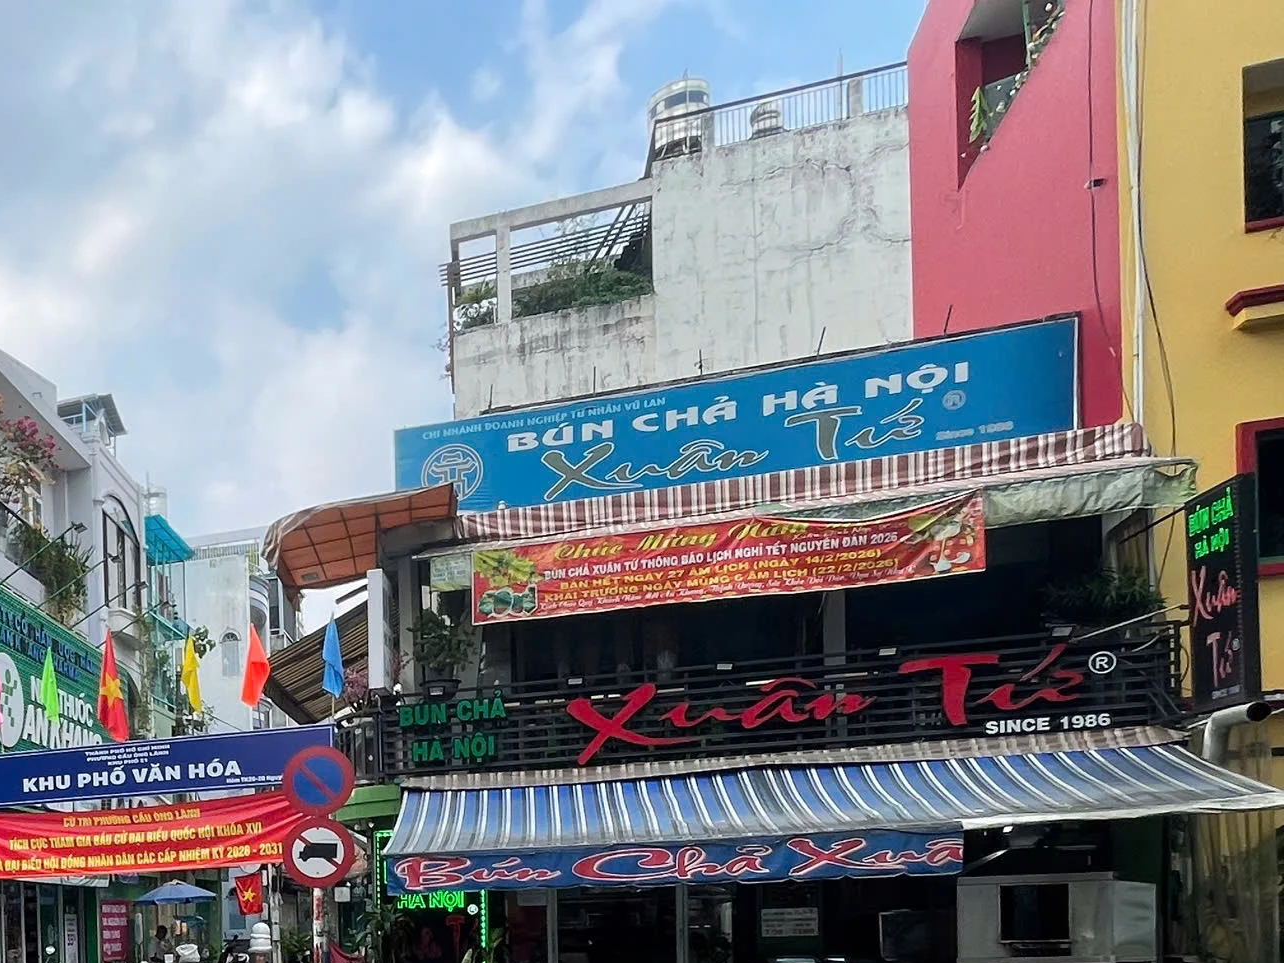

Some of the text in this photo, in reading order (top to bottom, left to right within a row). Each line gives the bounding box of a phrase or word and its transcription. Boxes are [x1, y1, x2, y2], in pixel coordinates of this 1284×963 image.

[422, 430, 441, 440] CHI
[443, 423, 482, 438] NHÁNH
[485, 418, 524, 431] DOANH
[527, 412, 567, 428] NGHIỆP
[588, 403, 623, 417] NHÂN
[643, 397, 666, 409] LAN
[507, 362, 970, 453] BÚN CHẢ HÀ NỘI
[540, 398, 924, 502] Xuân Tứ
[1188, 505, 1210, 537] BÚN
[544, 569, 566, 581] BÚN
[568, 565, 590, 578] CHẢ
[592, 563, 621, 576] XUÂN
[640, 556, 678, 569] THÔNG
[681, 552, 704, 564] BÁO
[706, 548, 732, 563] LỊCH
[765, 541, 787, 556] TẾT
[790, 535, 840, 553] NGUYÊN
[870, 532, 898, 543] 2026
[668, 569, 684, 578] 27
[716, 561, 749, 574] LỊCH
[544, 591, 578, 602] KHAI
[773, 568, 807, 580] LỊCH
[398, 688, 506, 728] BÚN CHẢ
[567, 643, 1084, 765] Xuân Tứ
[985, 713, 1112, 735] SINCE 1986
[412, 732, 496, 763] HÀ NỘI
[23, 756, 242, 793] KHU PHỐ VĂN HÓA
[50, 837, 74, 849] THAM
[76, 836, 91, 847] GIA
[170, 825, 196, 841] QUỐC
[217, 822, 244, 837] KHÓA
[245, 821, 262, 834] XVI
[88, 853, 114, 868] NHÂN
[115, 852, 135, 866] DÂN
[136, 851, 156, 865] CÁC
[157, 847, 176, 863] CẤP
[259, 842, 283, 856] 2031
[395, 857, 561, 890] Bún
[571, 845, 770, 881] Chả
